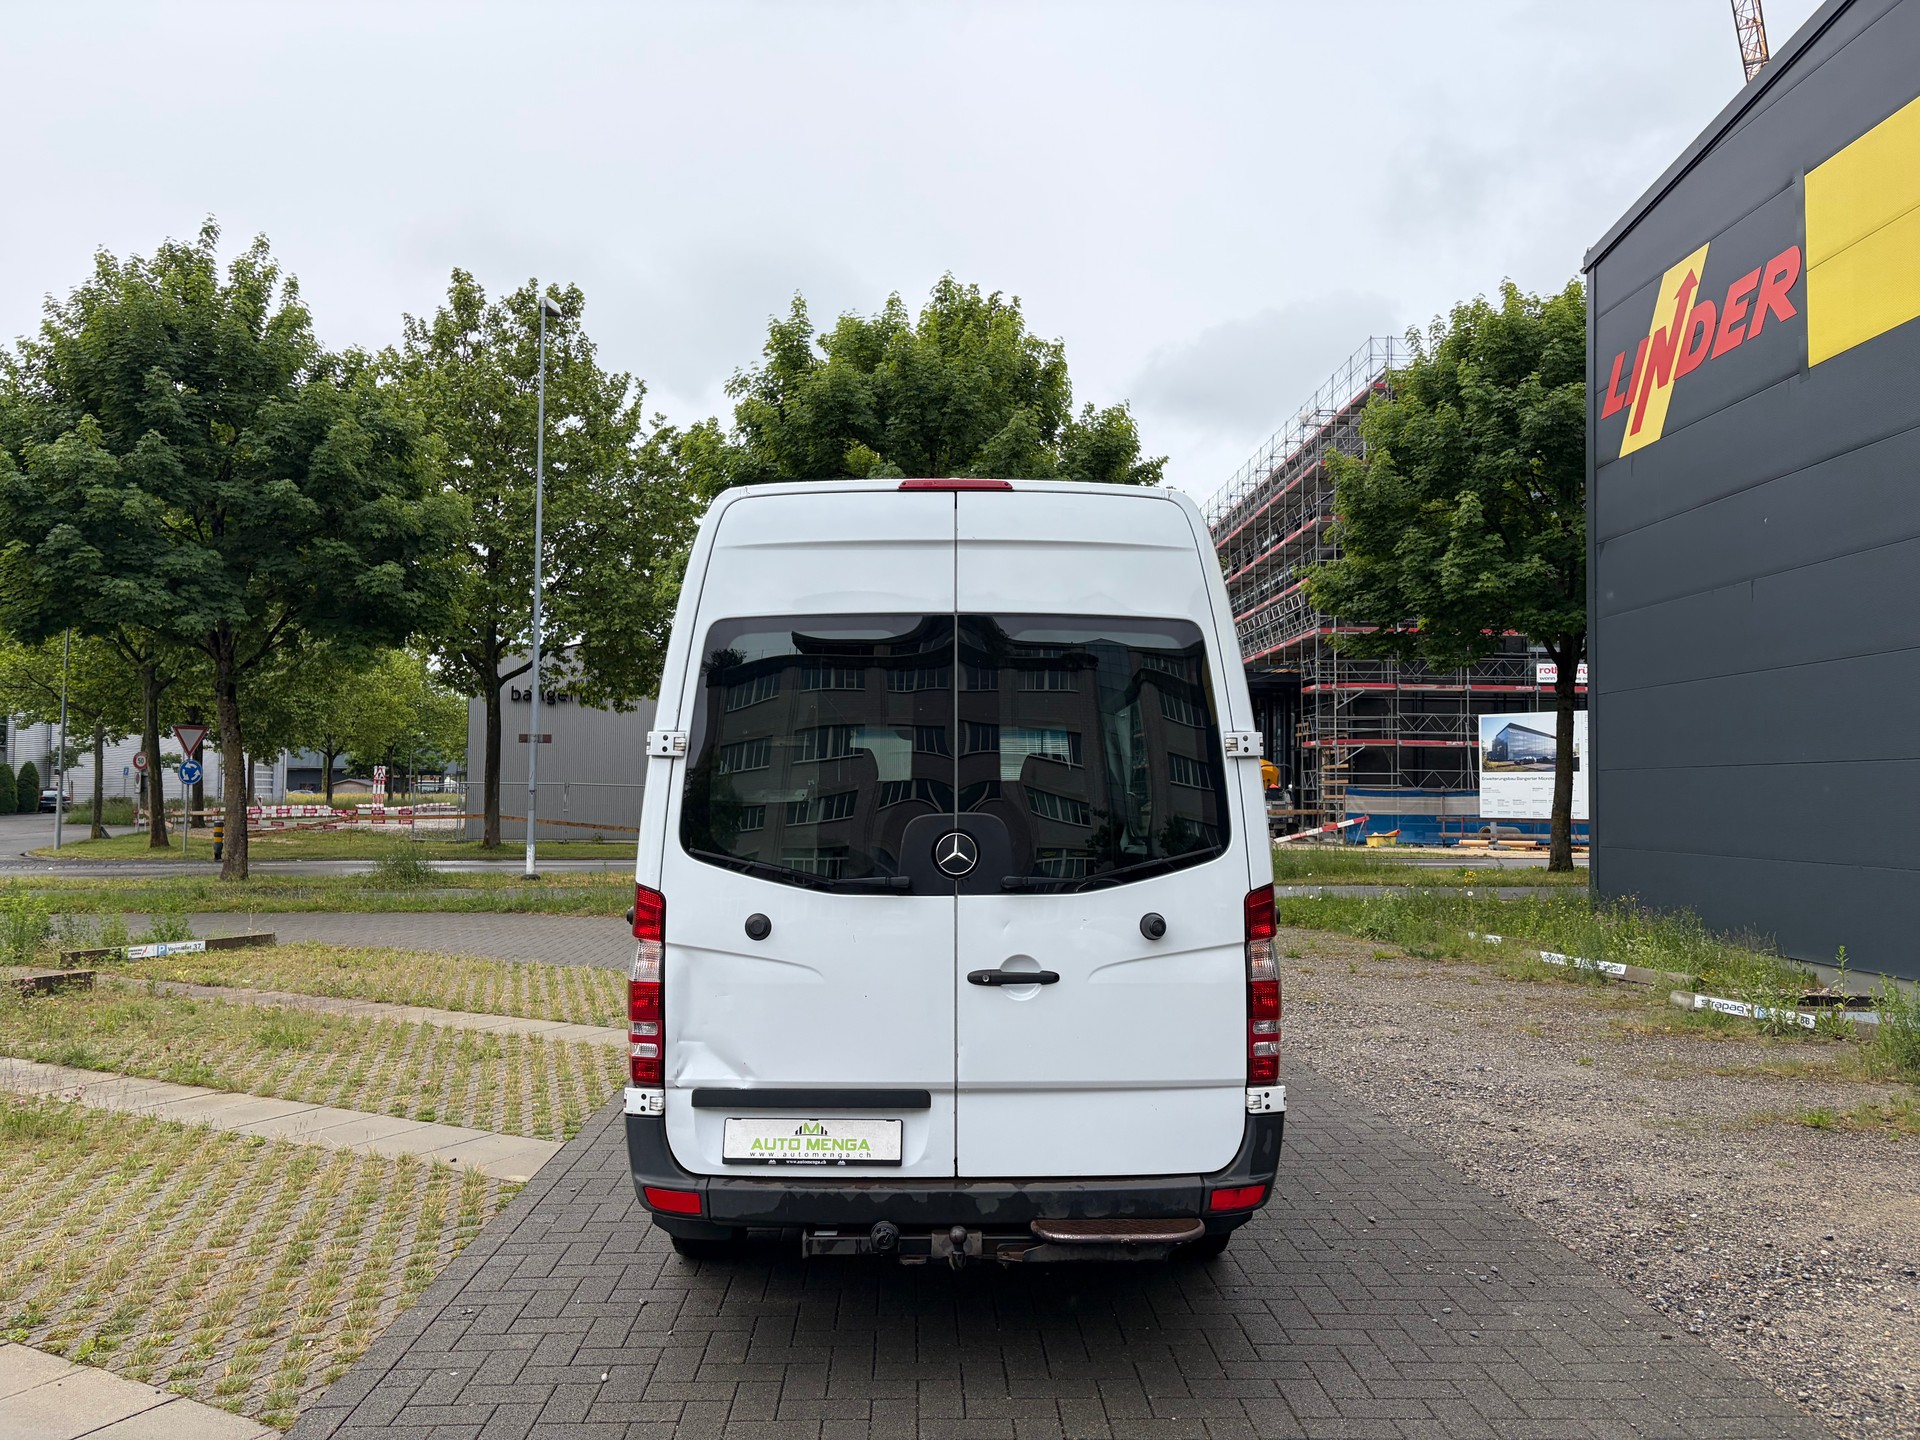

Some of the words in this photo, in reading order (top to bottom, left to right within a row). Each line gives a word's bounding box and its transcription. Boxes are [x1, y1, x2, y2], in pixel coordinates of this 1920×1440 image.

[1601, 245, 1801, 436] LINDER
[137, 757, 145, 765] 50
[751, 1137, 801, 1151] AUTO
[806, 1138, 871, 1151] MENGA
